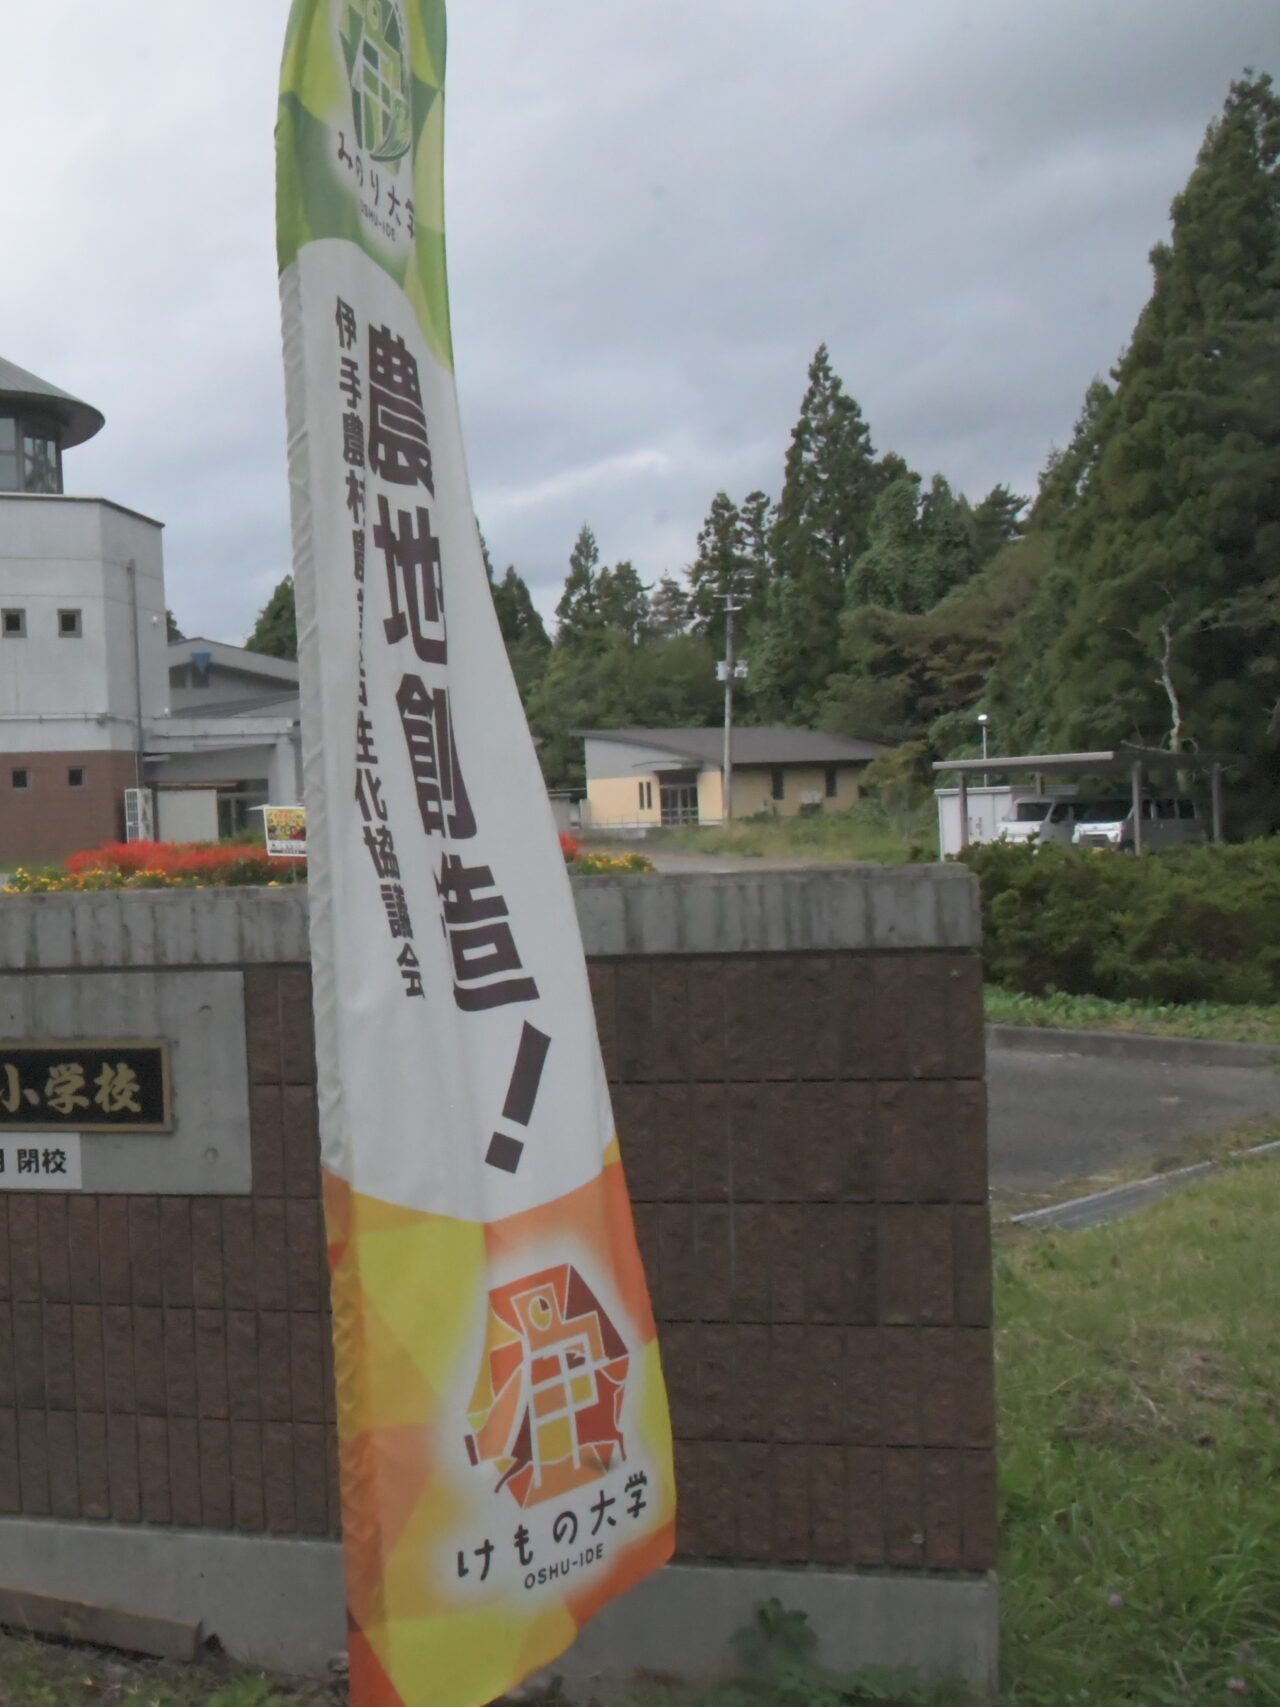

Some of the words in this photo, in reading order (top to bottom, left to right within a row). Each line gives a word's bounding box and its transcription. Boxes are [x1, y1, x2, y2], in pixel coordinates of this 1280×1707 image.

[17, 1148, 66, 1175] 閉校
[457, 1471, 647, 1581] けもの大学
[524, 1544, 603, 1589] OSHU-IDE
